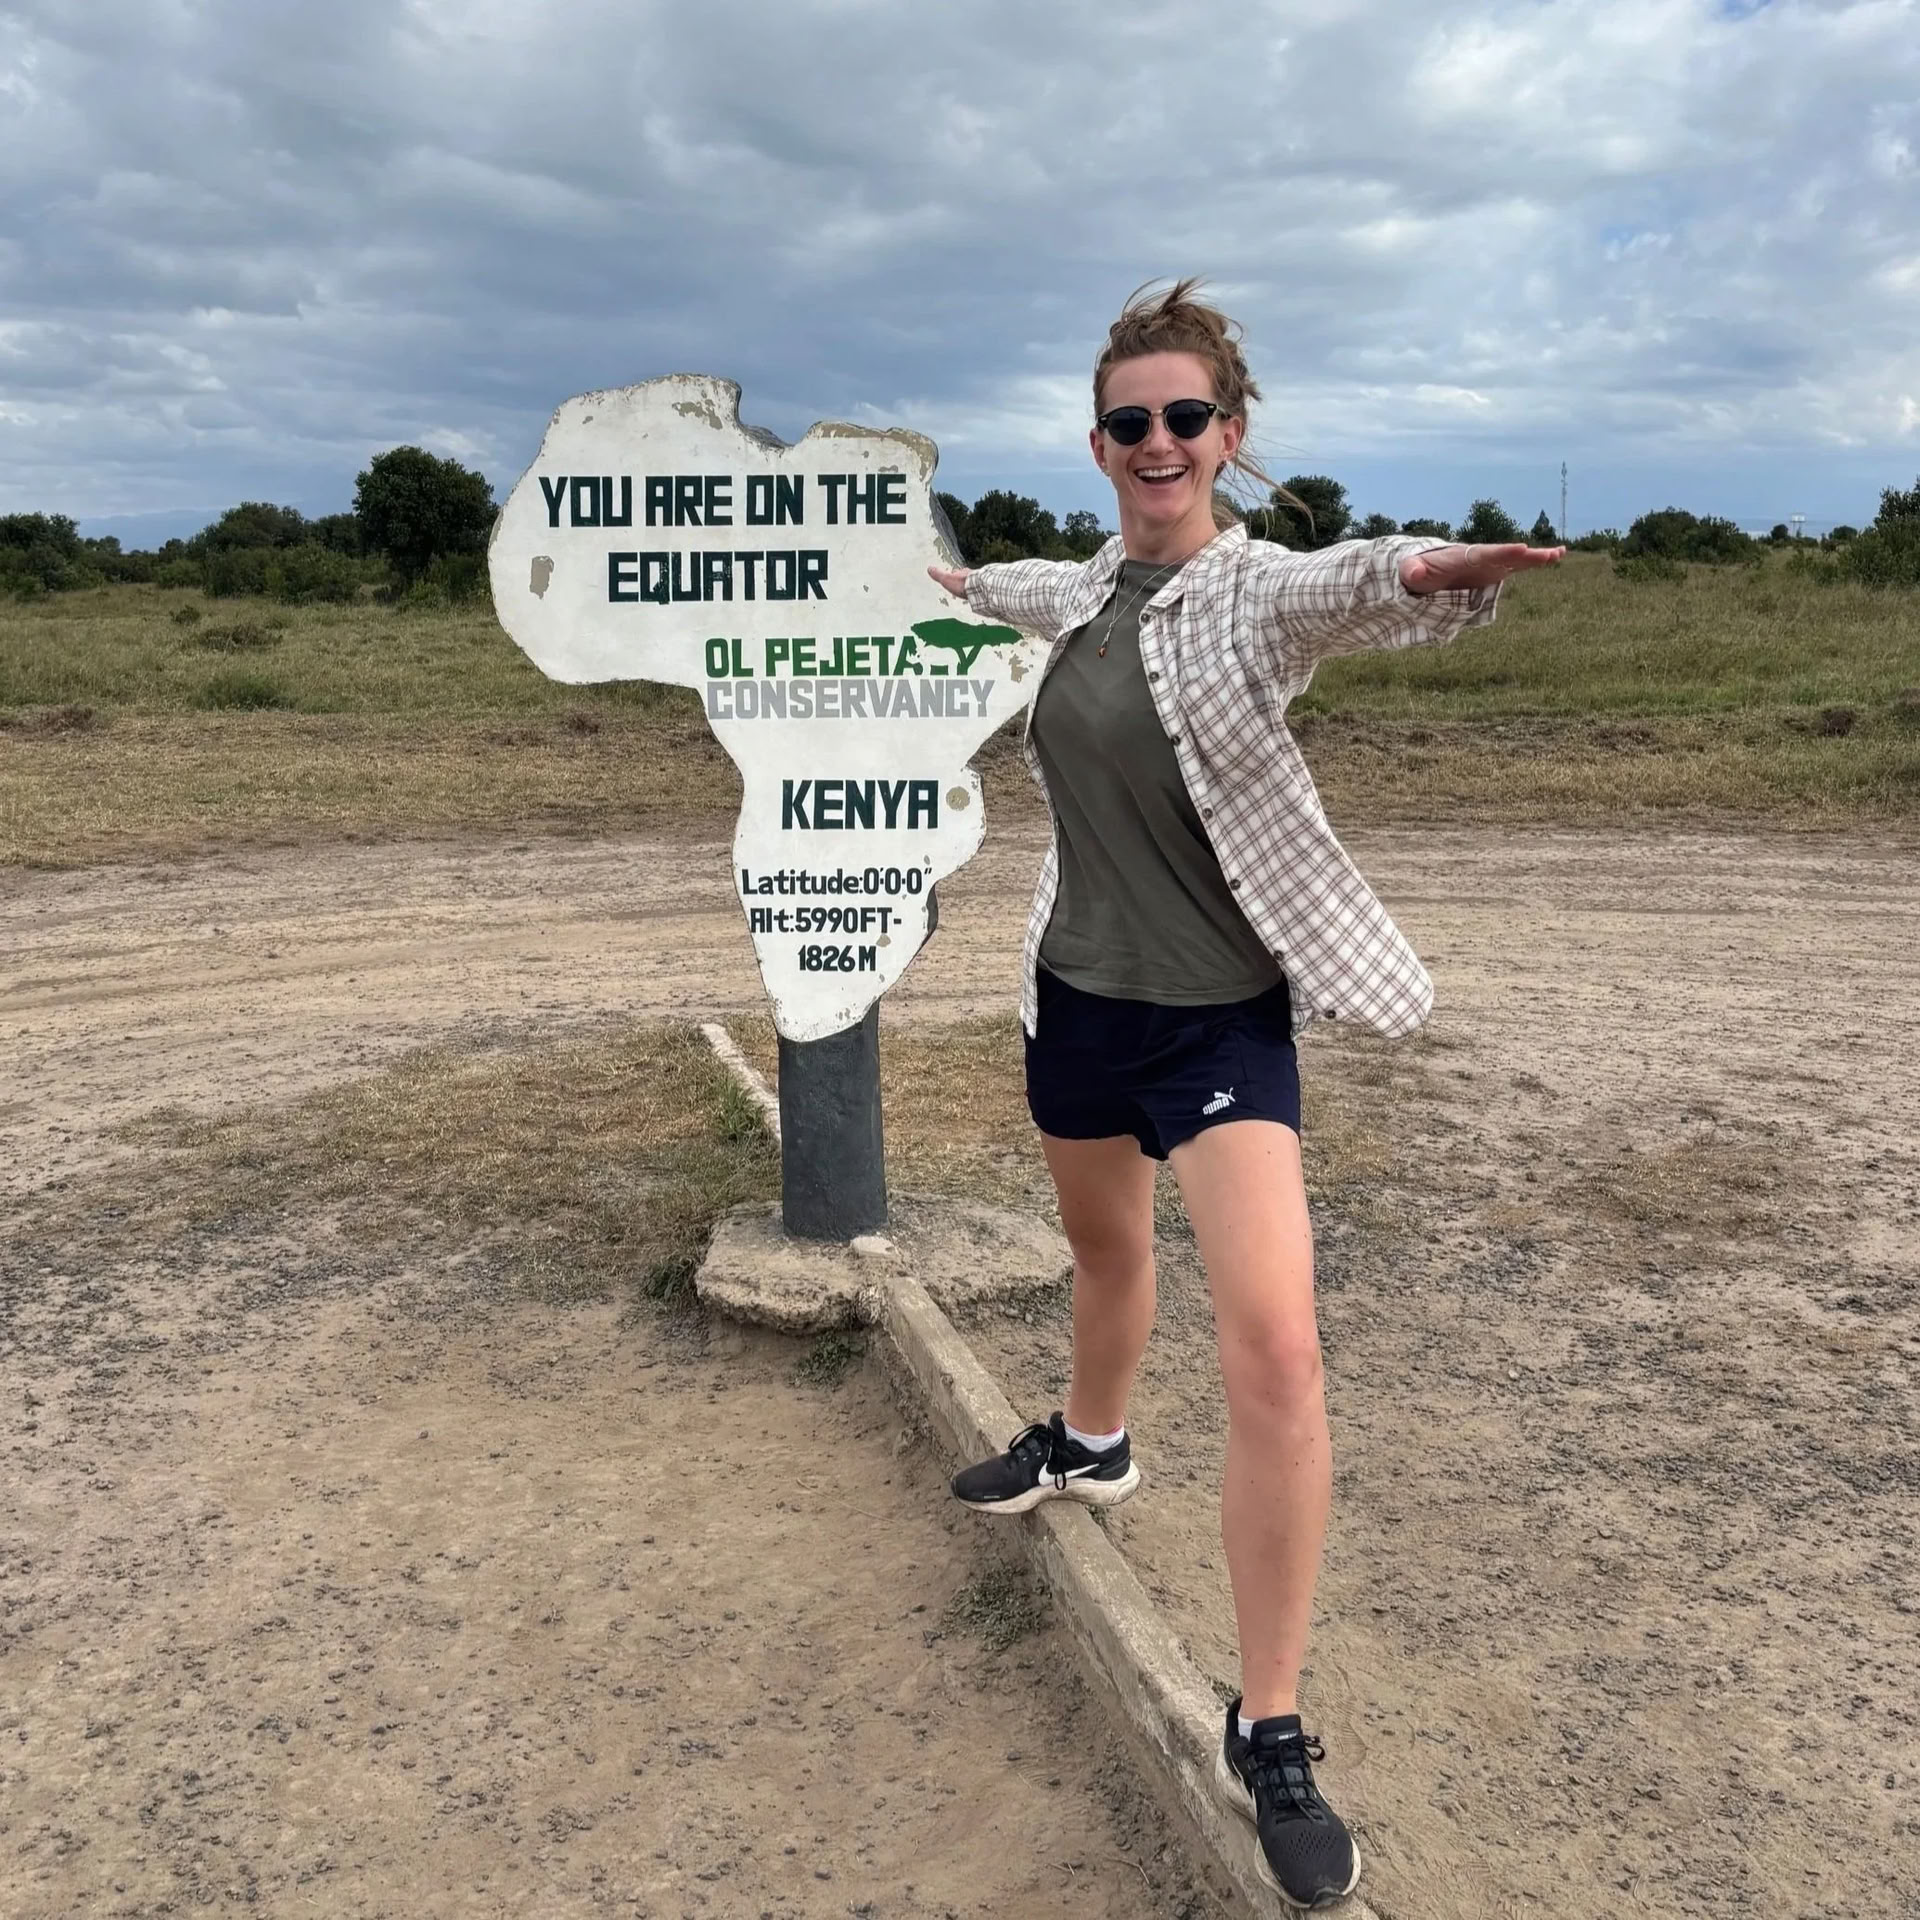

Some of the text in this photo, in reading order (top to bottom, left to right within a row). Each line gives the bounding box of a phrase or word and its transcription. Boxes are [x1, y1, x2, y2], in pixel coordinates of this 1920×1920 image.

[539, 473, 907, 527] YOU ARE ON THE
[608, 549, 828, 604] EQUATOR
[705, 636, 923, 678] OL PEJETA
[706, 679, 996, 720] CONSERVANCY
[782, 780, 938, 830] KENYA
